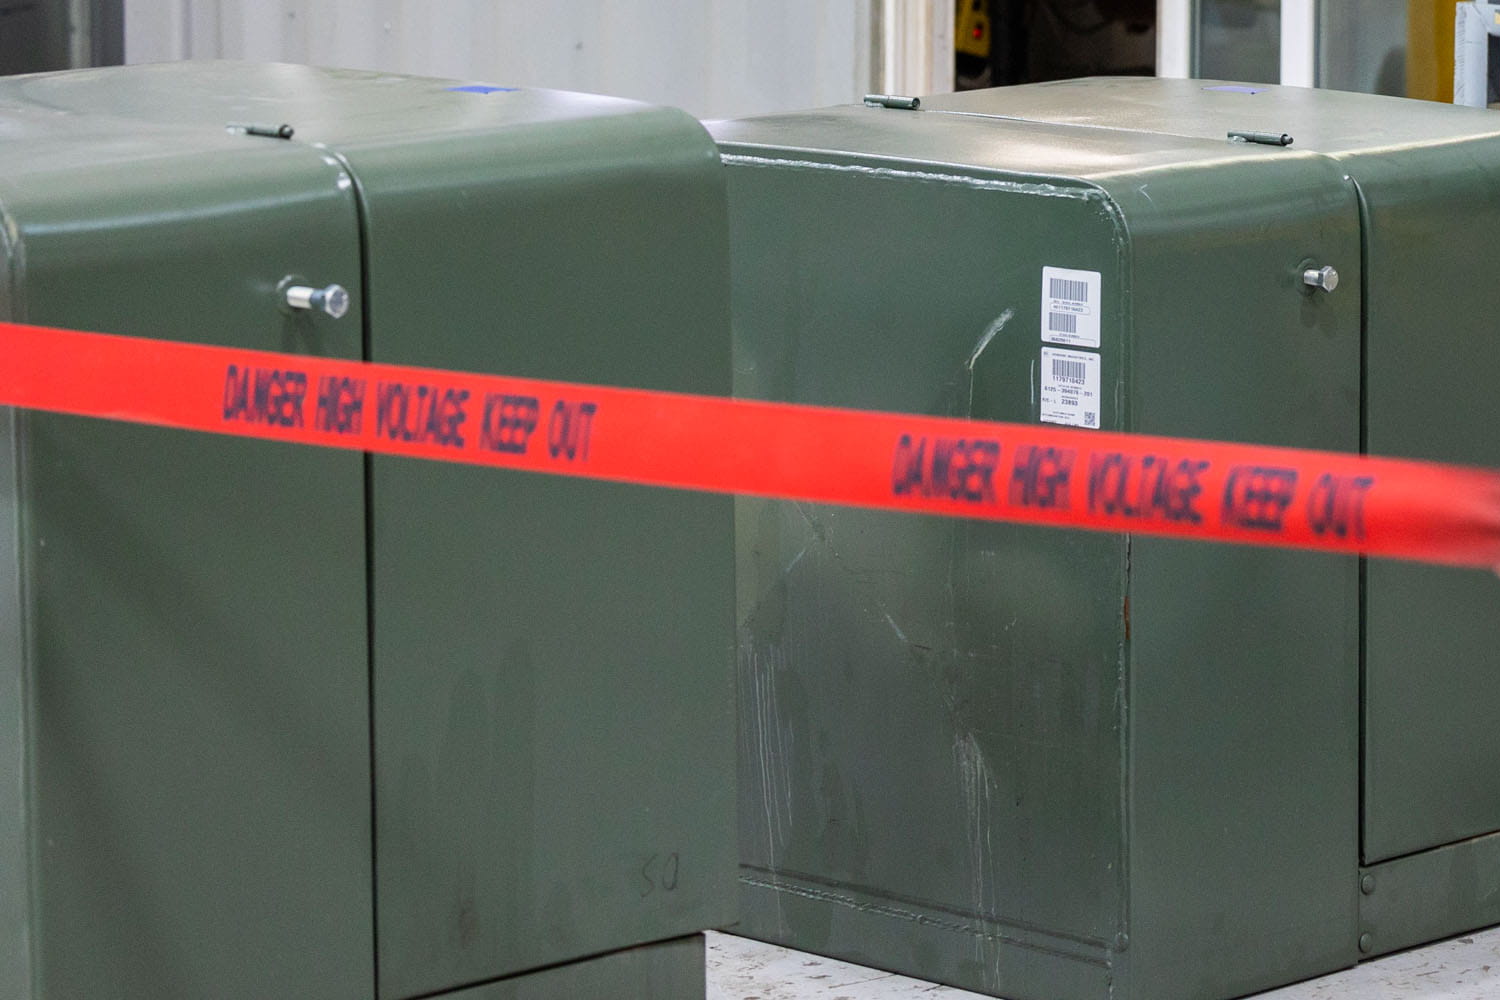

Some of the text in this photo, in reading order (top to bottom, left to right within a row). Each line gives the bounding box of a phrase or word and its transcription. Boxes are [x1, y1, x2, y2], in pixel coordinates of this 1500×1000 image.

[223, 364, 597, 463] DANGER HIGH VOLTAGE KEEP OUT
[892, 434, 1374, 541] DANGER HIGH VOLTAGE KEEP OUT
